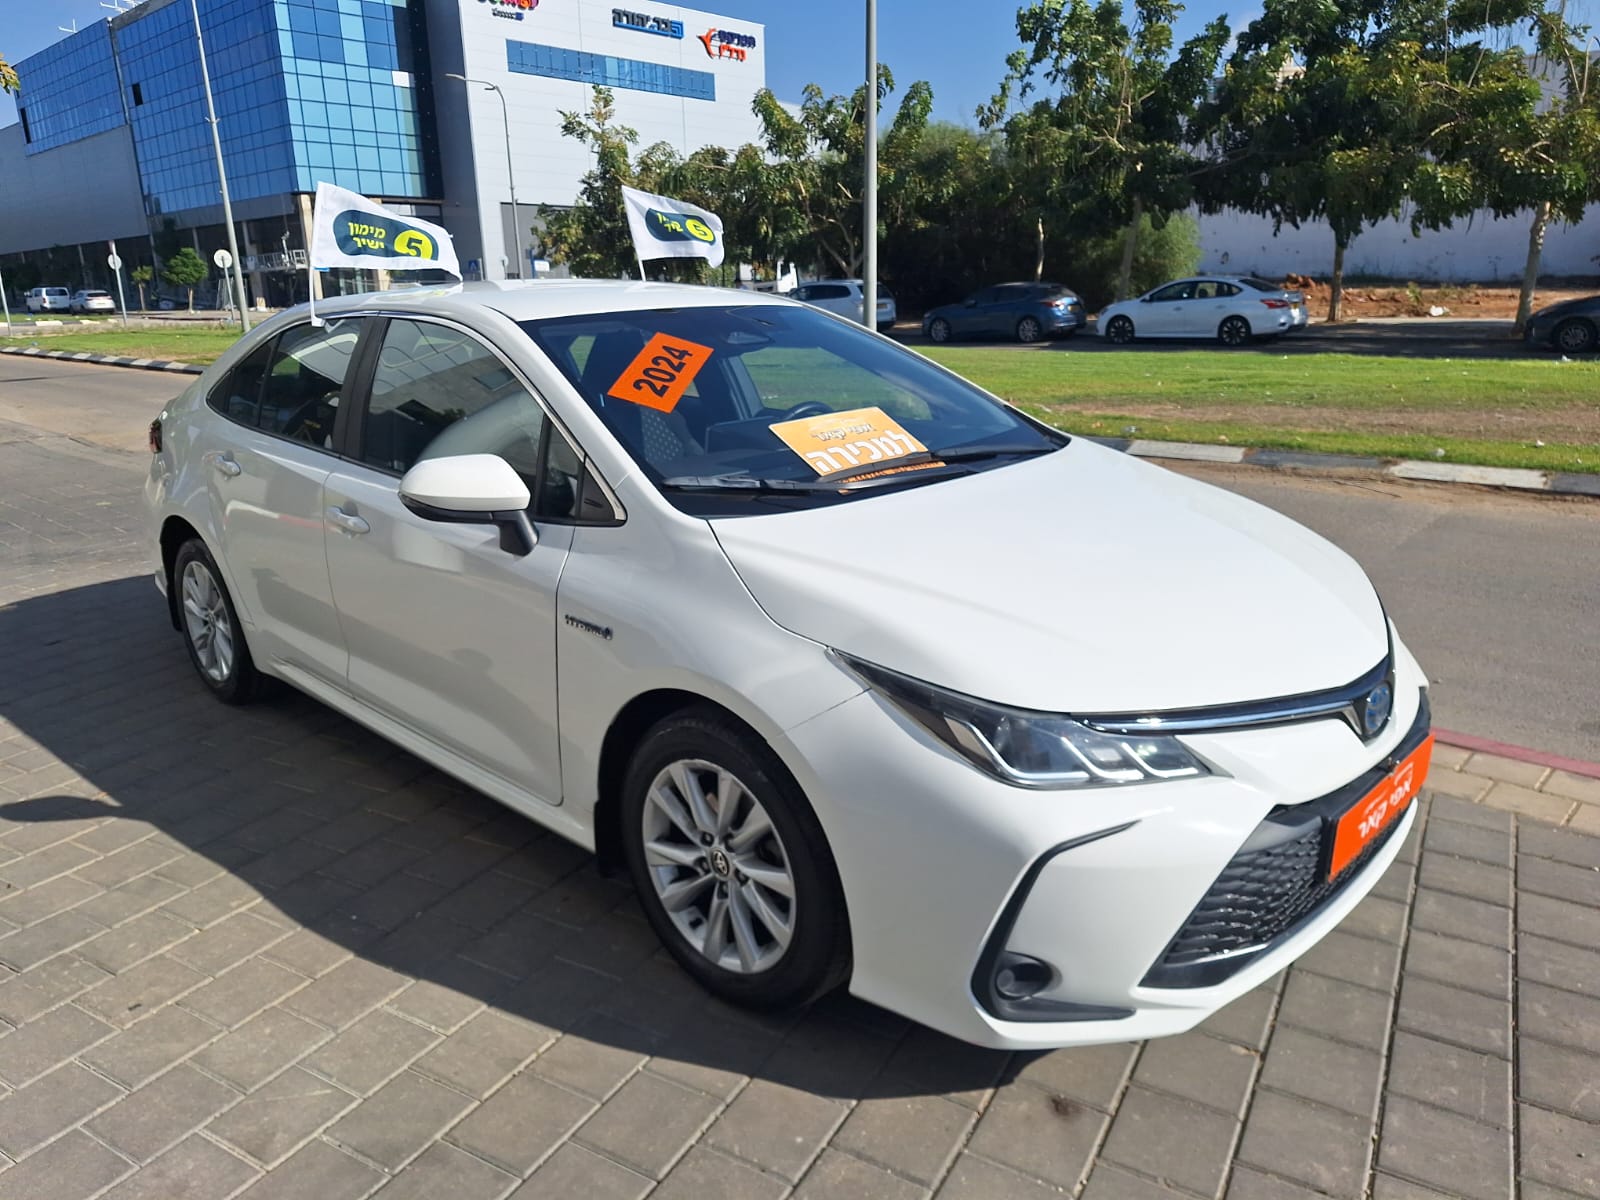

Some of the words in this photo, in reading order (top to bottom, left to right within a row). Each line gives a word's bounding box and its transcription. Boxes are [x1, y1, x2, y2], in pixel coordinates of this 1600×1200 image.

[348, 222, 386, 239] מימון
[352, 236, 386, 250] ישיר
[406, 236, 423, 258] 5
[632, 344, 693, 398] 2024
[805, 429, 917, 473] למכירה
